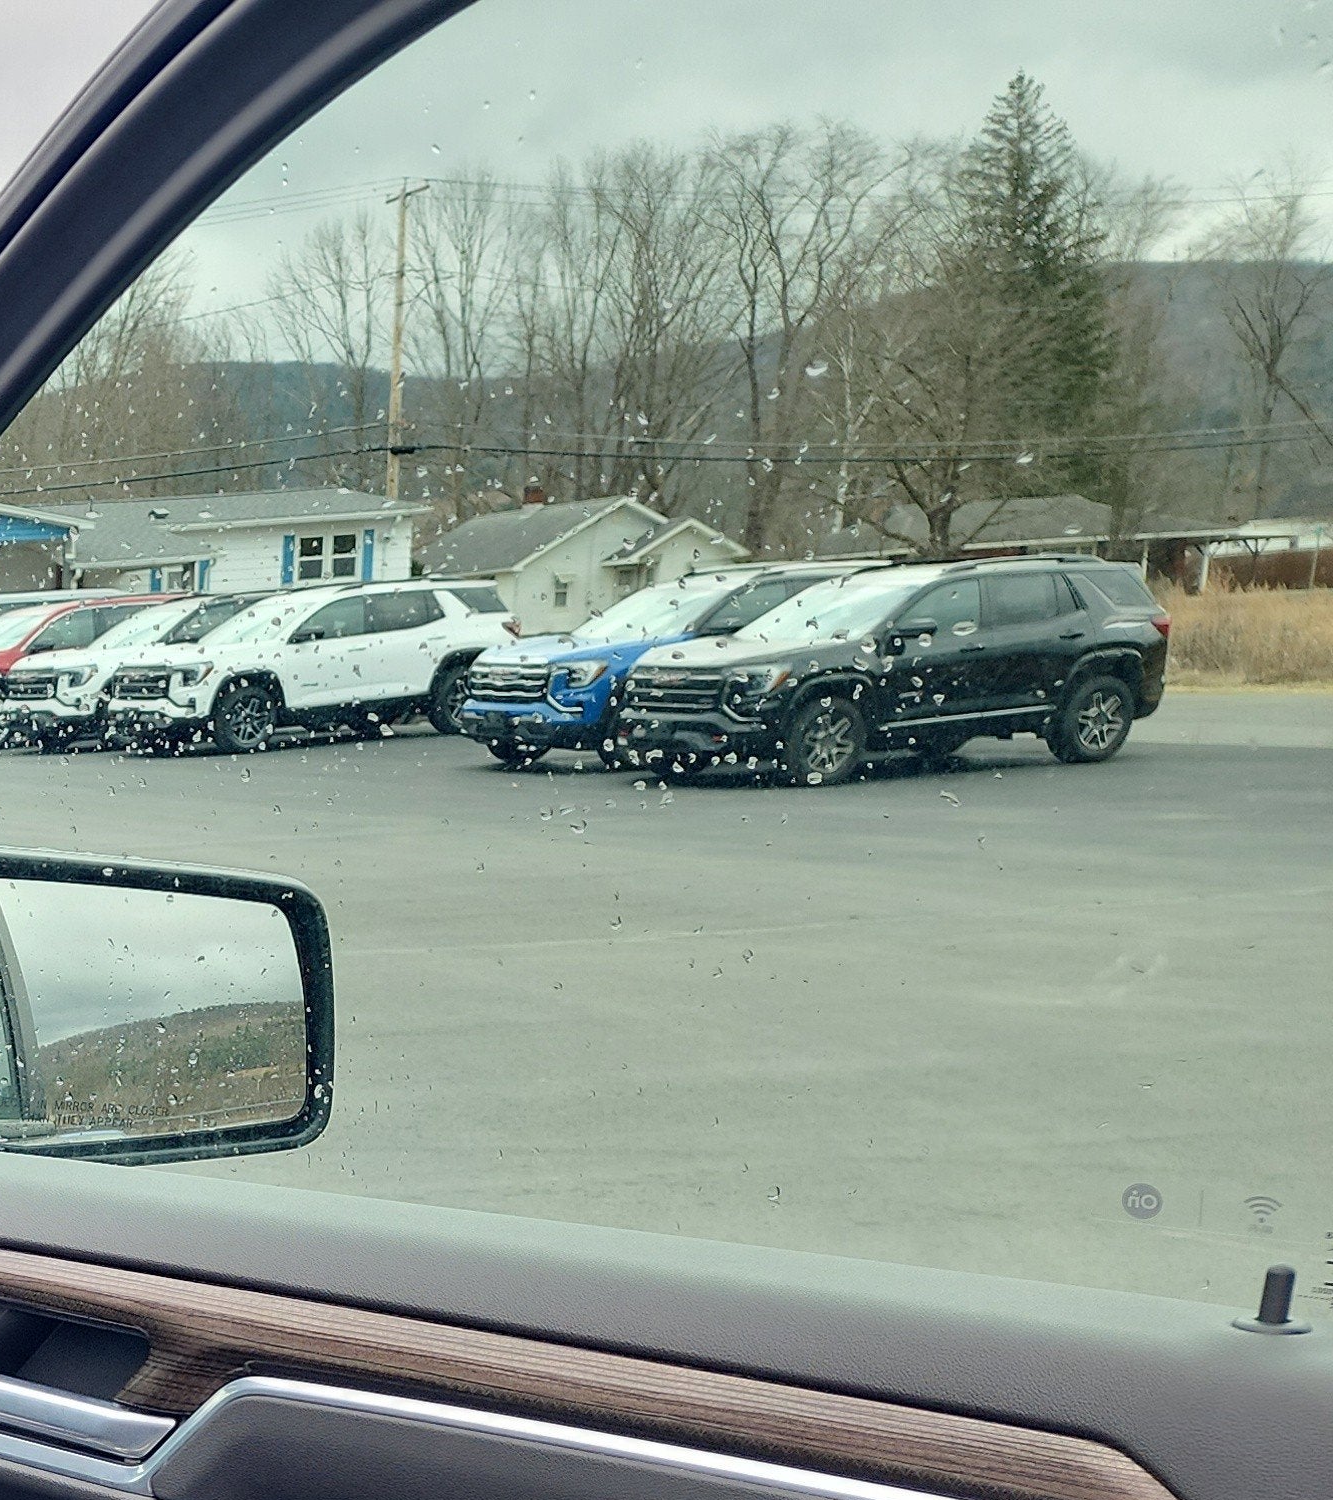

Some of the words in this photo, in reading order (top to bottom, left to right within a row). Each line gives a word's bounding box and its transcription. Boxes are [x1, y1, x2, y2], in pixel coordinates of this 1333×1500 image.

[54, 1100, 95, 1113] MIRROR
[128, 1104, 169, 1117] CLOSER
[55, 1113, 84, 1126] THEY
[88, 1116, 133, 1129] APPEAR
